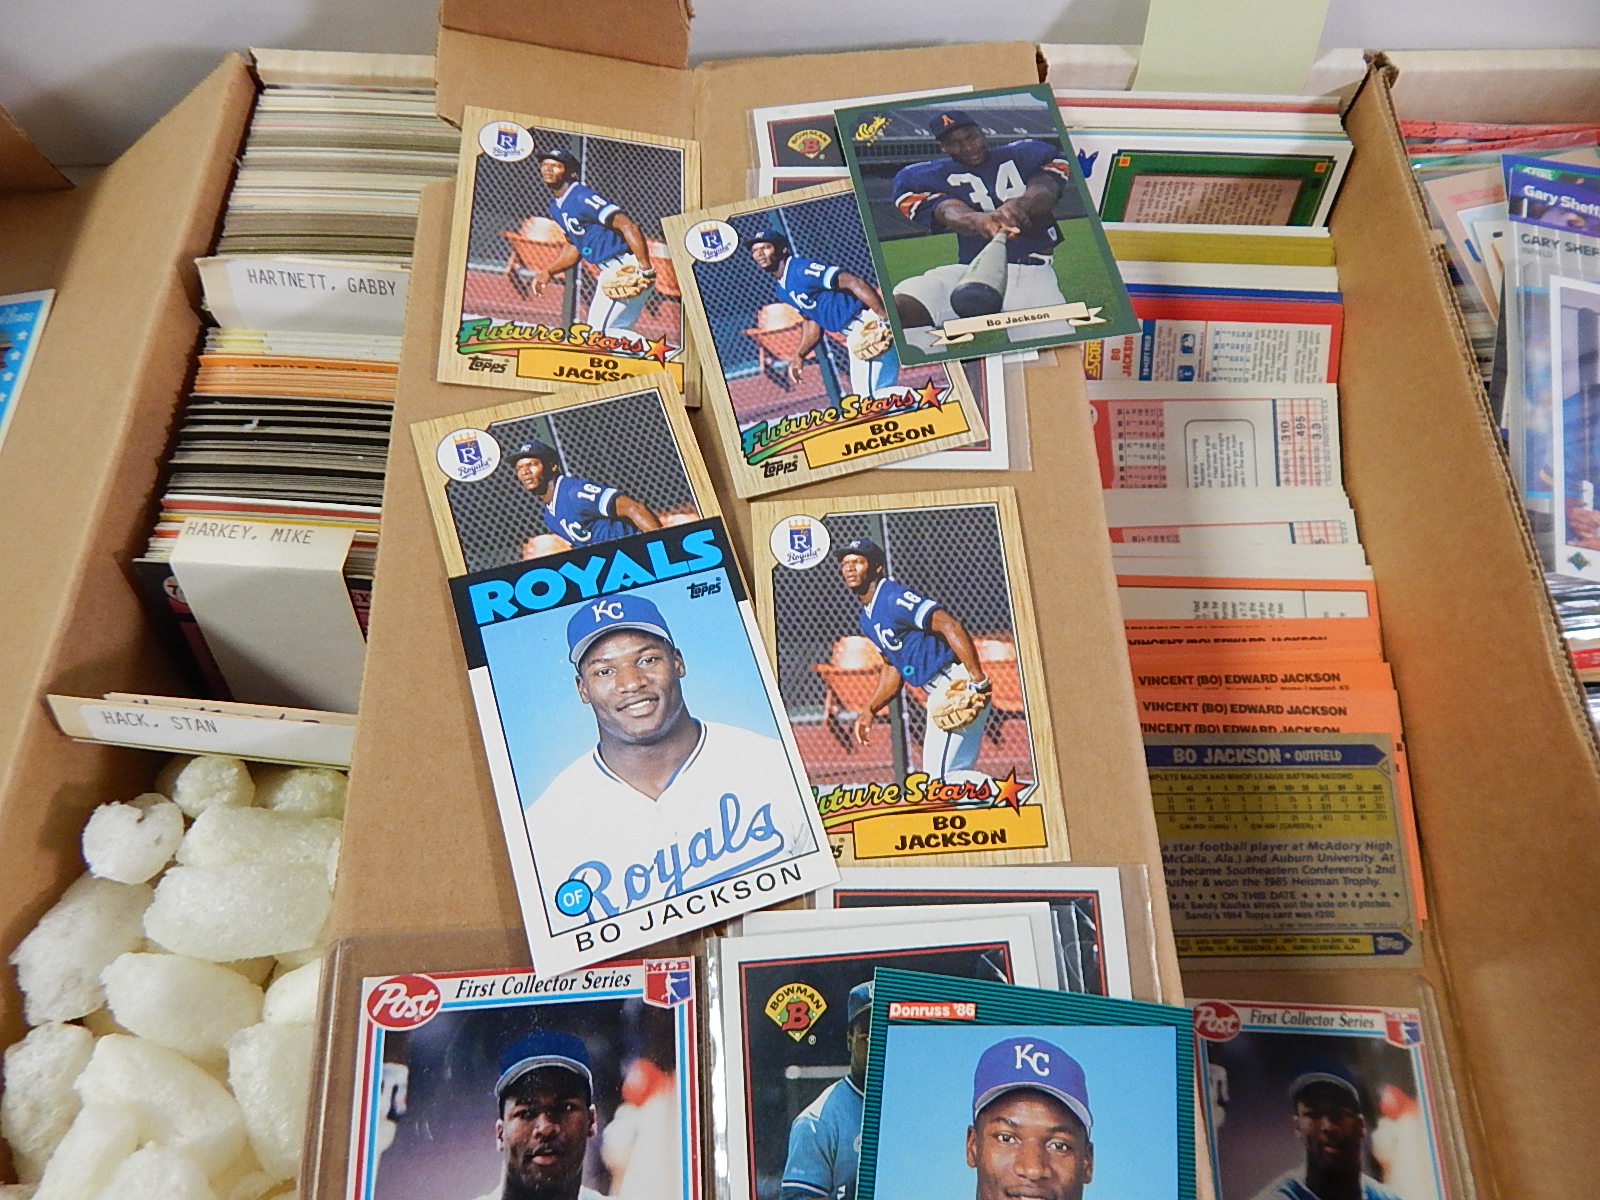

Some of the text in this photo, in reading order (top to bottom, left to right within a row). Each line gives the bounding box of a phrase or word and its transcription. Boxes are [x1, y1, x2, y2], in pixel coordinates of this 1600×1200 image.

[791, 130, 828, 145] BOWMAN
[800, 138, 821, 154] B
[947, 159, 1027, 212] 34
[1523, 184, 1559, 206] Gary
[1521, 233, 1560, 249] GARY
[247, 268, 398, 297] HARTNETT, GABBY
[986, 312, 1051, 327] Bo Jackson
[457, 318, 644, 352] Future Stars
[589, 357, 619, 370] BO
[741, 391, 914, 458] Future Stars
[869, 421, 899, 436] BO
[842, 424, 936, 456] JACKSON
[185, 521, 315, 545] HARKEY, MIKE
[786, 549, 819, 566] Royals
[467, 528, 724, 626] ROYALS
[592, 600, 624, 623] KC
[873, 622, 903, 651] KC
[1138, 672, 1341, 687] VINCENT (BO) EDWARD JACKSON
[1142, 701, 1348, 716] VINCENT (BO) EDWARD JACKSON
[102, 710, 160, 729] HACK,
[172, 716, 219, 734] STAN
[1173, 748, 1343, 763] BO JACKSON OUTFIELD
[811, 772, 991, 815] uture Stars
[932, 815, 967, 831] BO
[894, 829, 1007, 852] JACKSON
[1173, 843, 1196, 851] star
[1199, 841, 1248, 851] football
[1250, 842, 1289, 853] player
[1292, 843, 1304, 851] at
[1307, 841, 1361, 853] McAdory
[1365, 841, 1393, 853] High
[567, 792, 785, 926] Royals
[1180, 865, 1223, 875] became
[1226, 865, 1299, 875] Southeastern
[1301, 864, 1371, 875] Conference's
[1374, 864, 1397, 875] 2nd
[1245, 853, 1268, 864] and
[1271, 853, 1314, 864] Auburn
[1380, 853, 1395, 863] At
[1214, 878, 1239, 887] won
[1242, 877, 1262, 886] the
[1264, 877, 1289, 886] 1985
[1292, 877, 1340, 886] Heisman
[562, 888, 585, 908] OF
[1222, 891, 1297, 900] ON THIS DATE
[575, 862, 803, 952] BO JACKSON
[645, 960, 691, 972] MLB
[455, 970, 632, 999] First Collector Series
[370, 982, 440, 1020] Post
[769, 985, 823, 1012] BOWMAN
[781, 1001, 812, 1031] B
[889, 1003, 976, 1019] Donruss '86
[1194, 1005, 1239, 1034] Post
[1251, 1010, 1375, 1029] First Collector Series
[1014, 1043, 1050, 1077] KC
